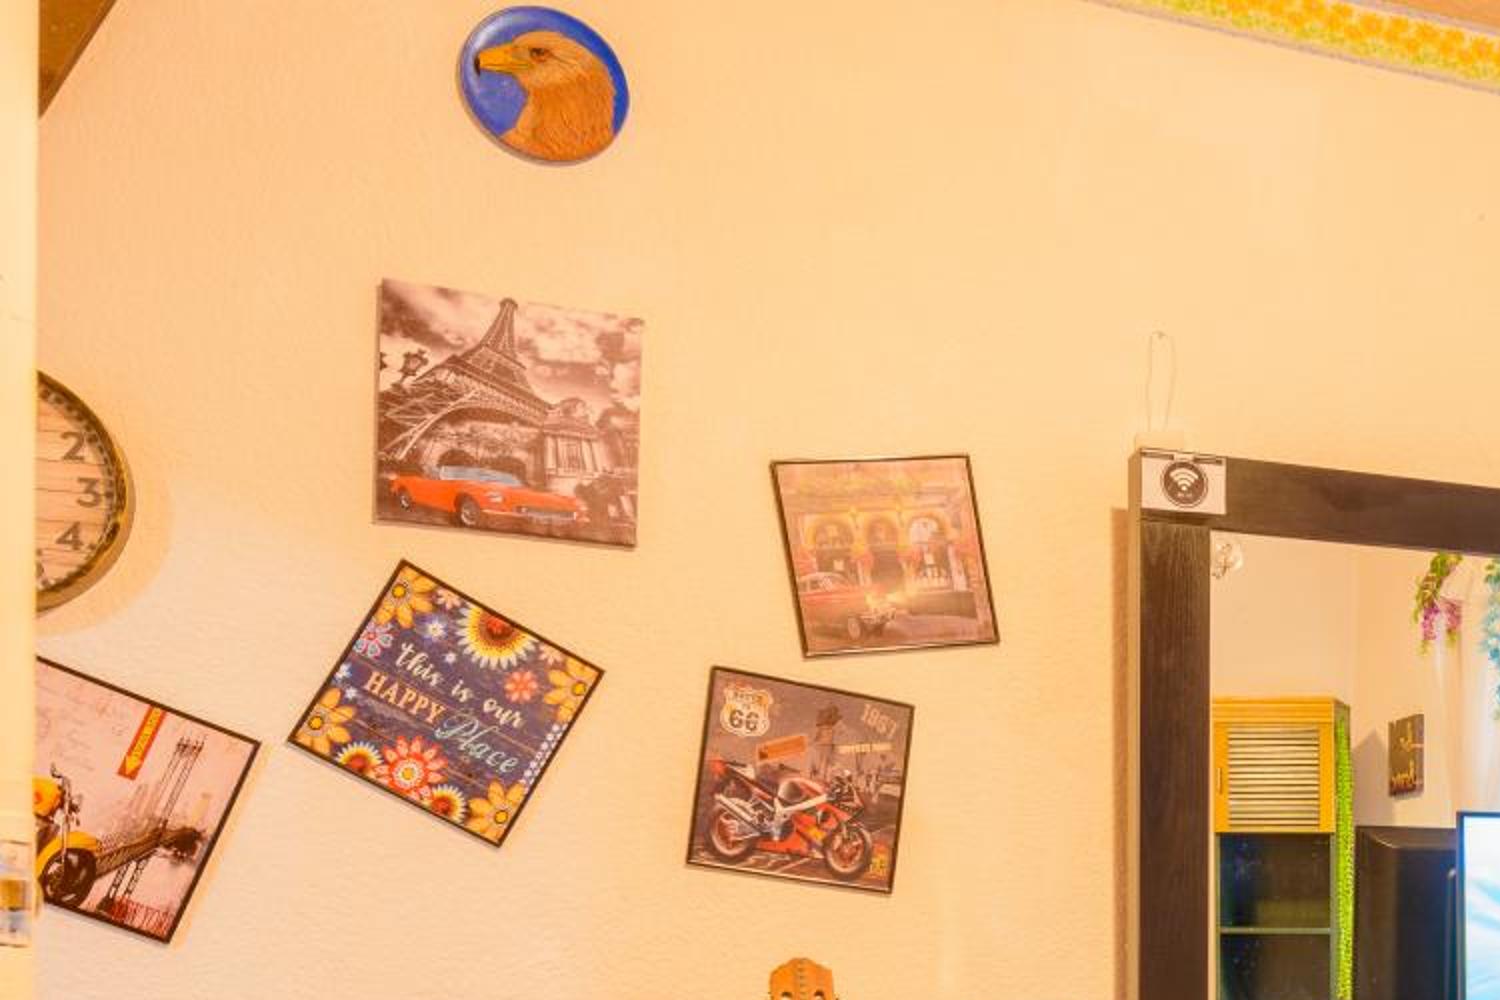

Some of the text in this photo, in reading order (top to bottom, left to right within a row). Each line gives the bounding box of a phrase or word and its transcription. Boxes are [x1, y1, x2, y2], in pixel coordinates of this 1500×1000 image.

[60, 431, 84, 461] 2
[76, 477, 101, 508] 3
[56, 521, 82, 550] 4
[395, 642, 525, 728] this is our
[363, 671, 519, 773] HAPPY Place
[729, 709, 760, 731] 66
